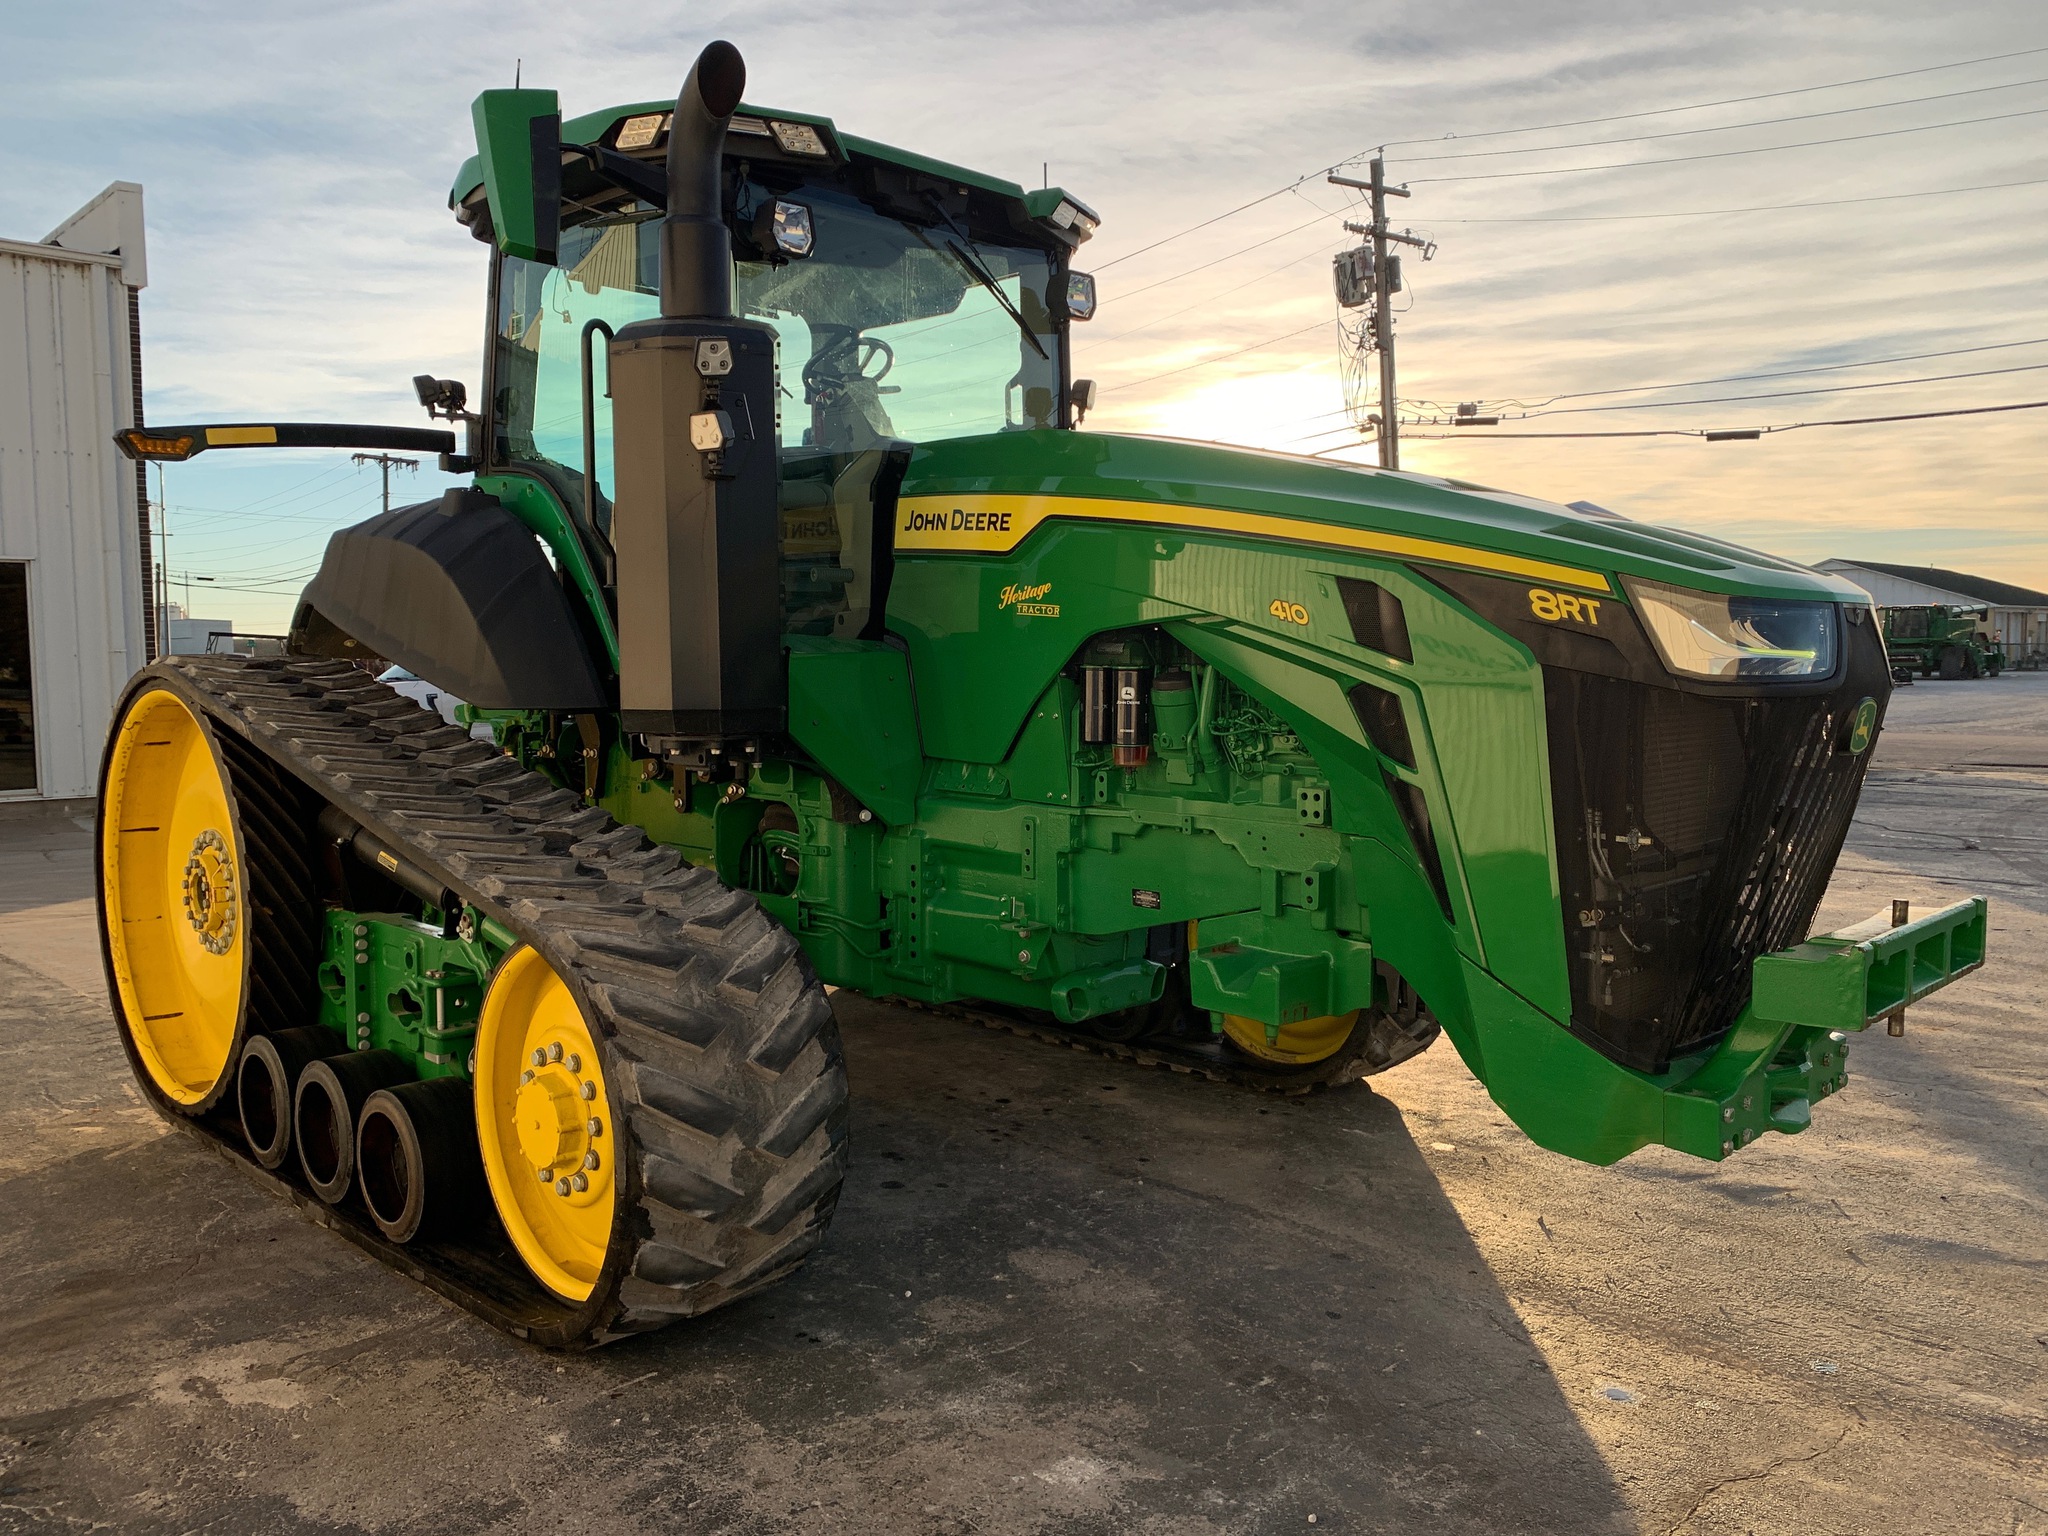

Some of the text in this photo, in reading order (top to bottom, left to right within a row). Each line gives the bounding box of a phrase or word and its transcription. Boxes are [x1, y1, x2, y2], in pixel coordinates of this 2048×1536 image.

[904, 509, 1012, 532] JOHN DEERE
[998, 582, 1052, 610] Heritage
[1528, 588, 1601, 625] 8RT
[1017, 605, 1060, 615] TRACTOR
[1269, 599, 1309, 626] 410
